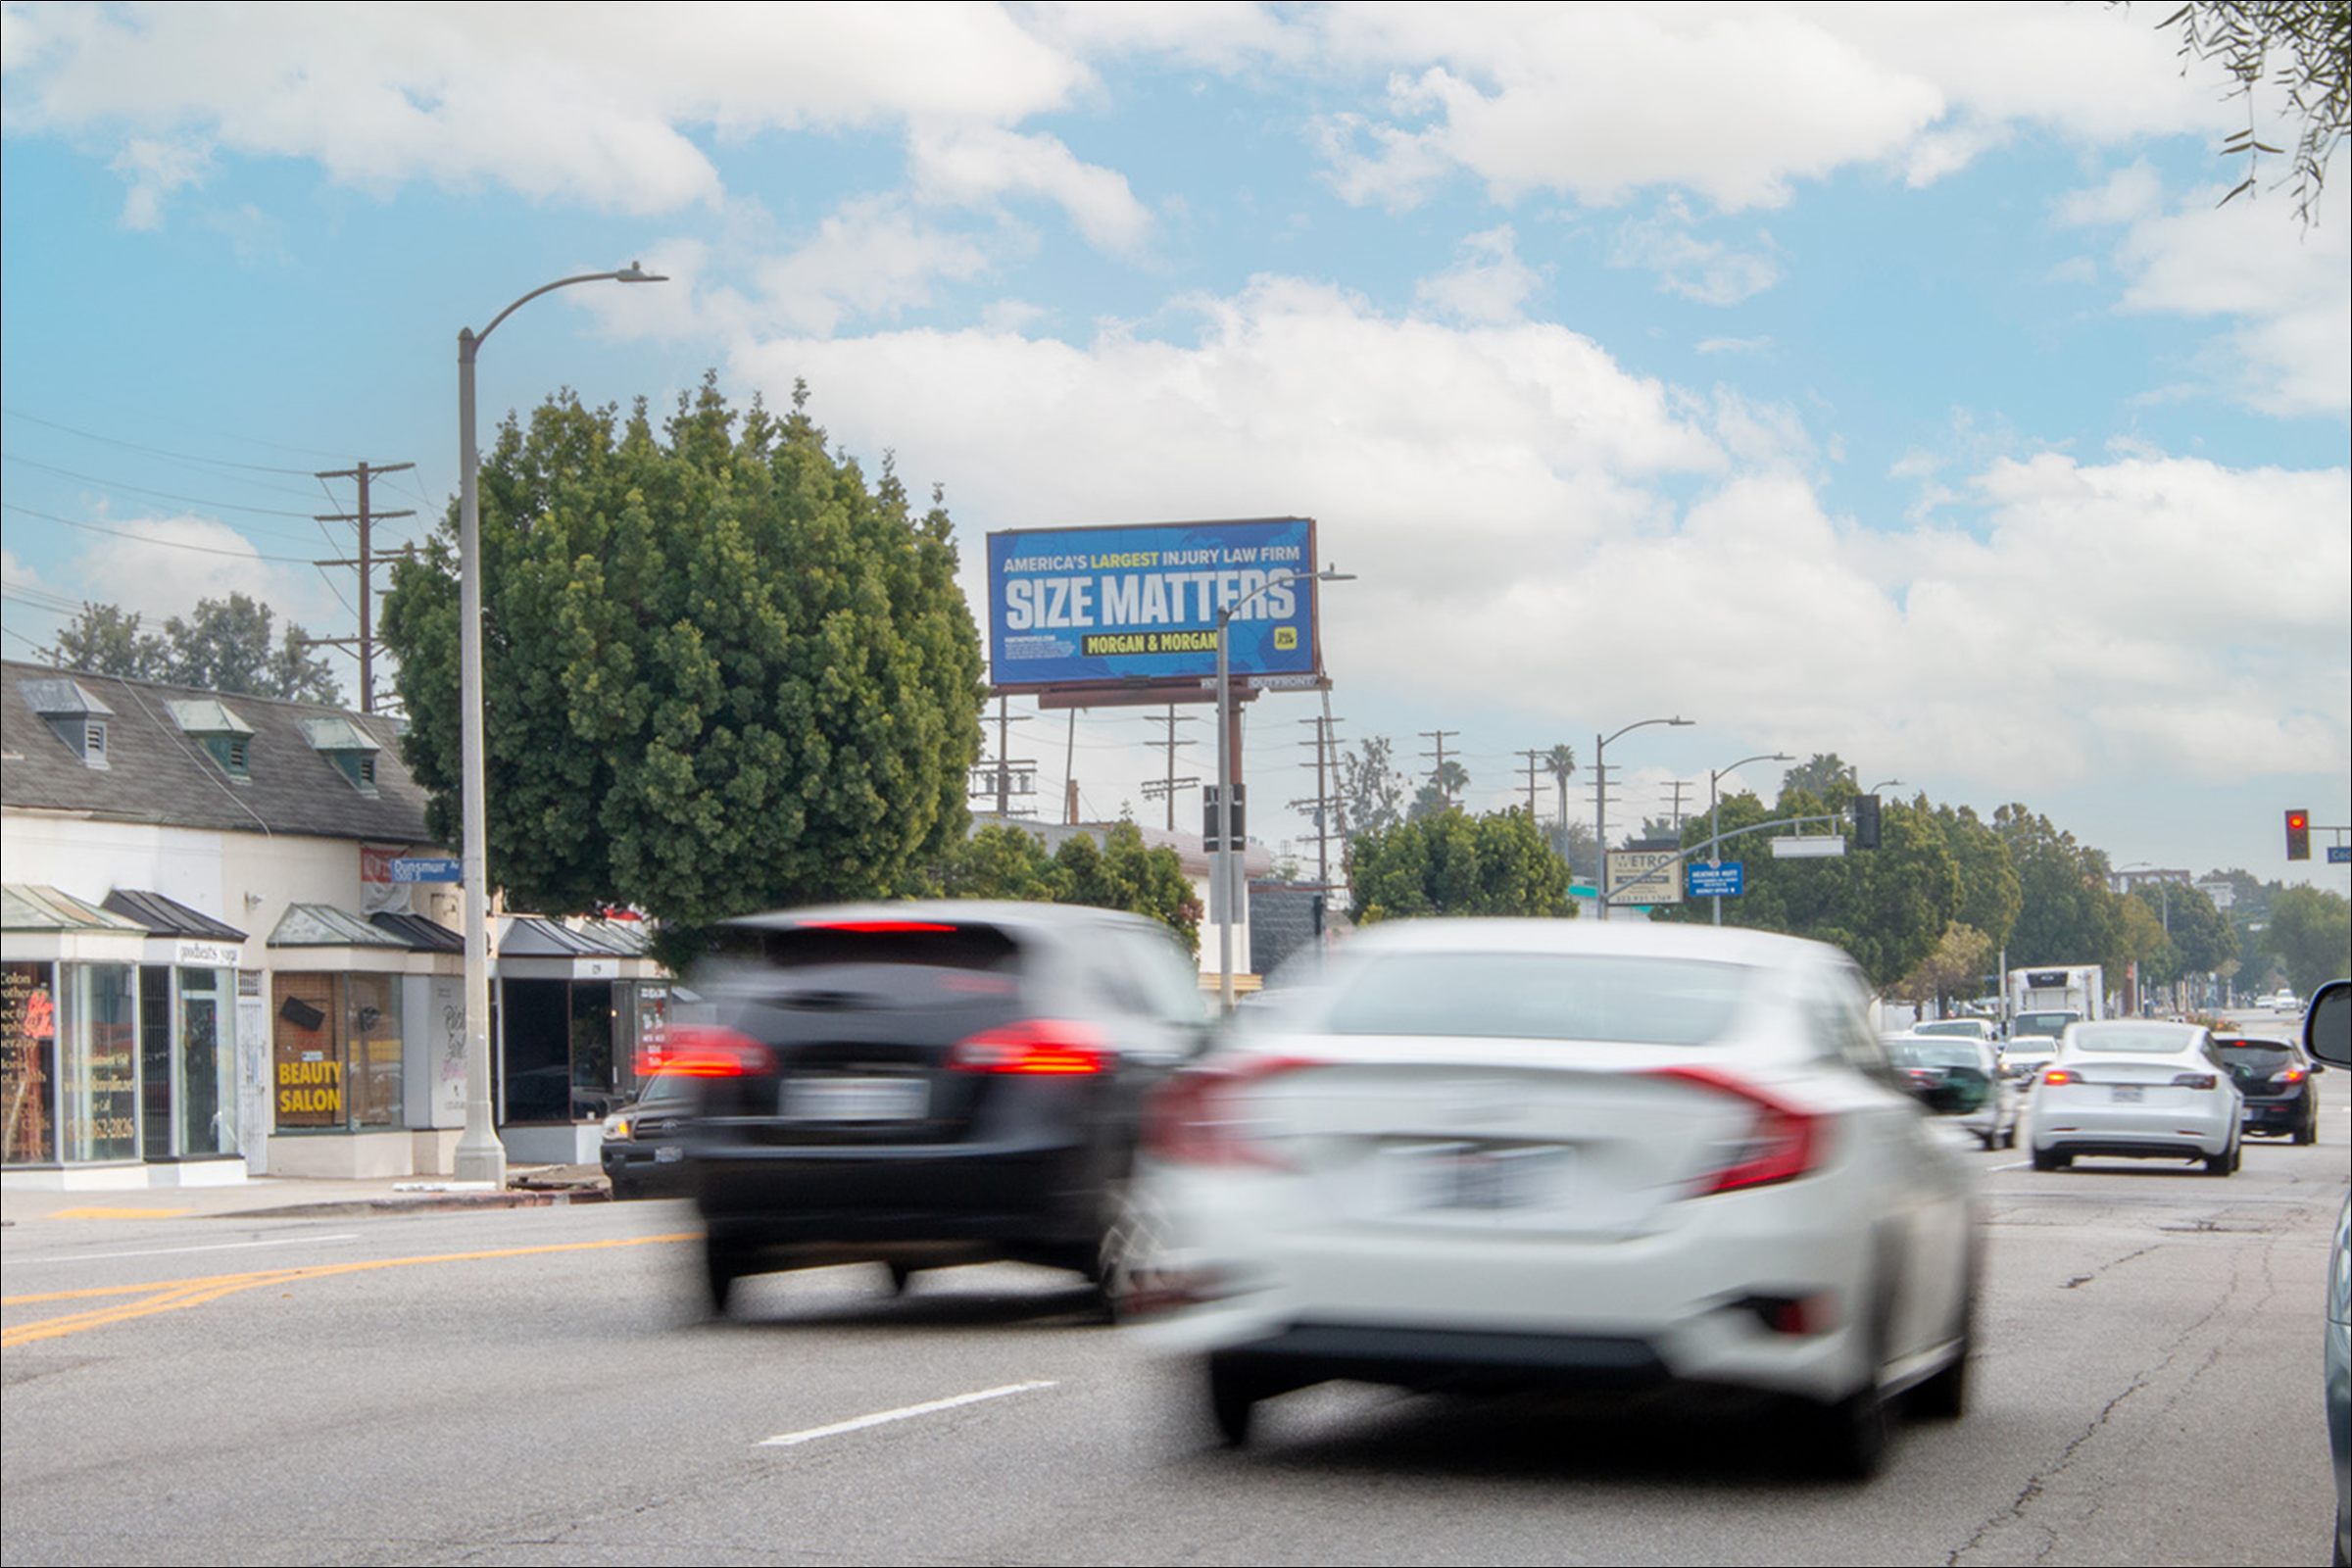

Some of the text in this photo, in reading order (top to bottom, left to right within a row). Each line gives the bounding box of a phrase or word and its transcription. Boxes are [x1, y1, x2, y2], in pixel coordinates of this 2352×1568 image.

[1004, 546, 1300, 572] AMERICA'S LARGEST INJURY LAW FIRM
[1005, 567, 1297, 630] SIZE MATTERS
[1088, 635, 1145, 654] MORGAN
[1148, 635, 1158, 651] &
[1161, 632, 1218, 651] MORGAN
[394, 859, 447, 874] Dunsmuir
[278, 1061, 342, 1085] BEAUTY
[279, 1089, 341, 1112] SALON
